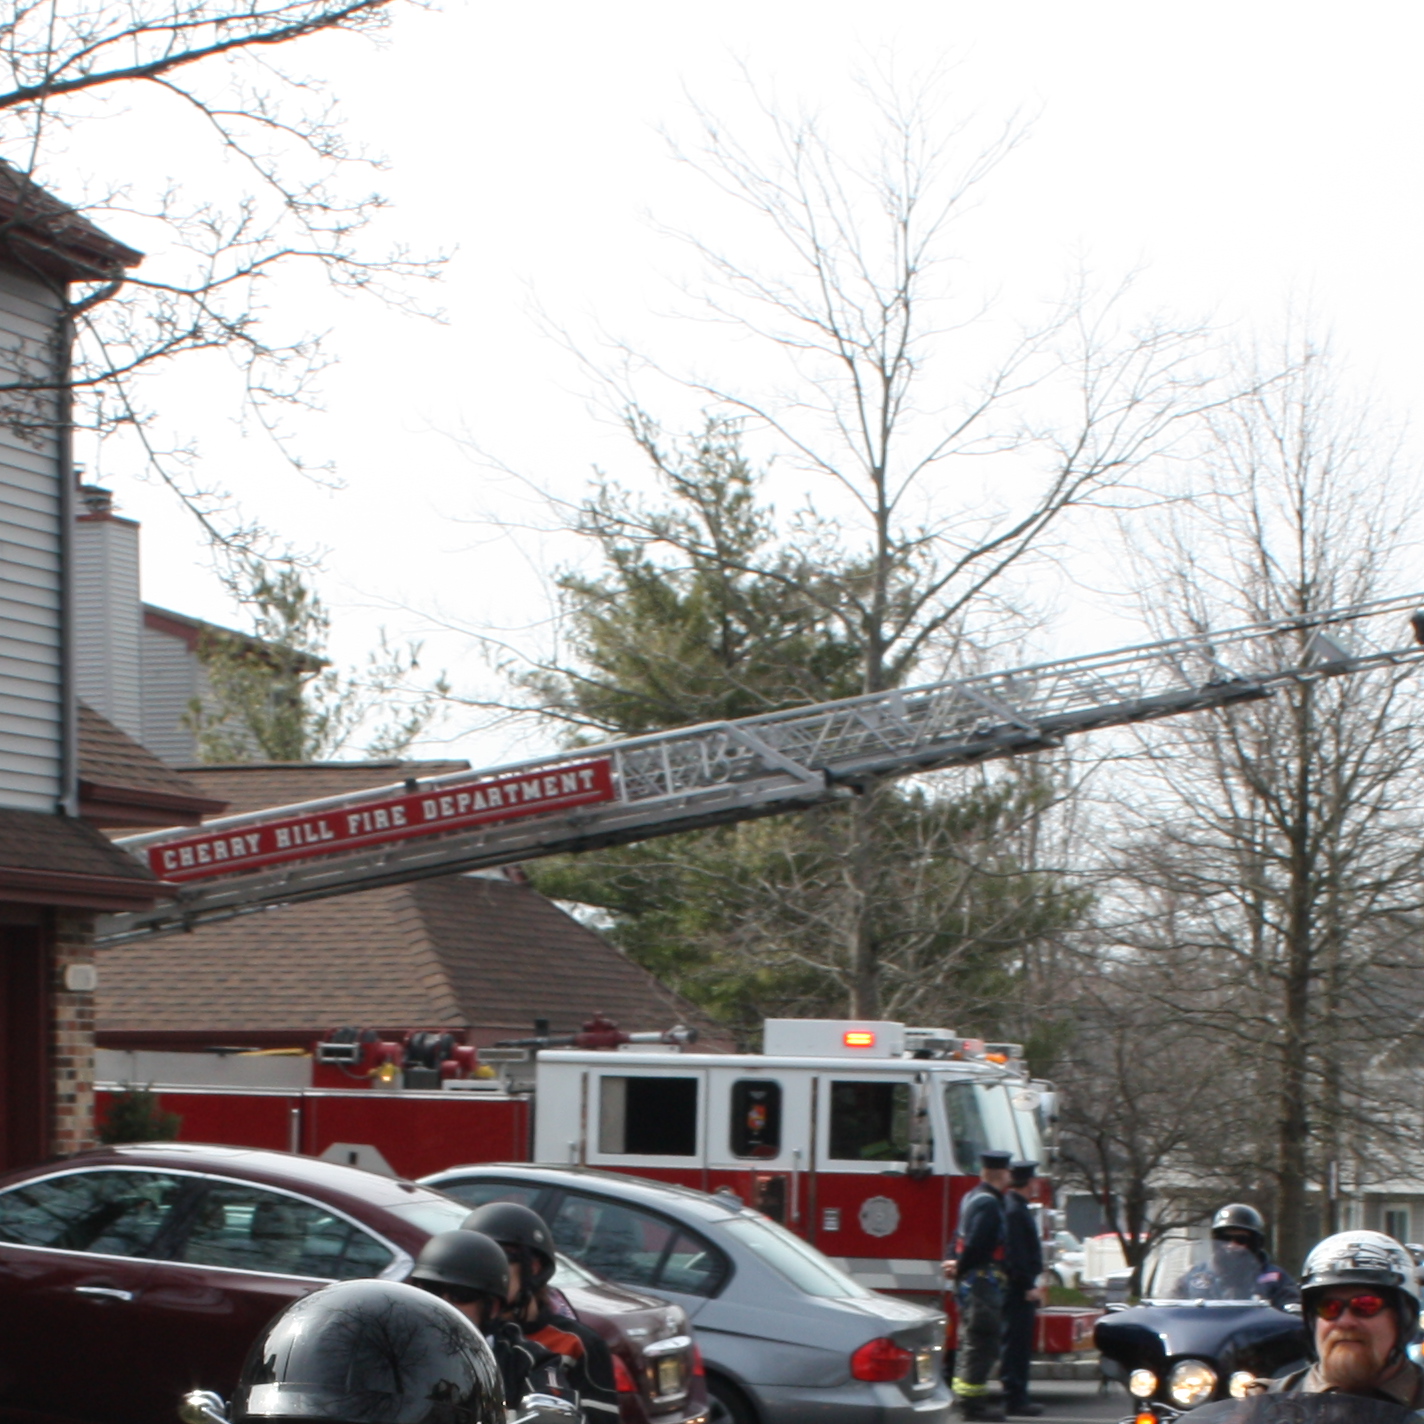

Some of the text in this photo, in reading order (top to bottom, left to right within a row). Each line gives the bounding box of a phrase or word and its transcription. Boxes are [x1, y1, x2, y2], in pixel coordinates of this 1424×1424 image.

[162, 767, 598, 871] CHERRY HILL FIRE DEPARTMENT
